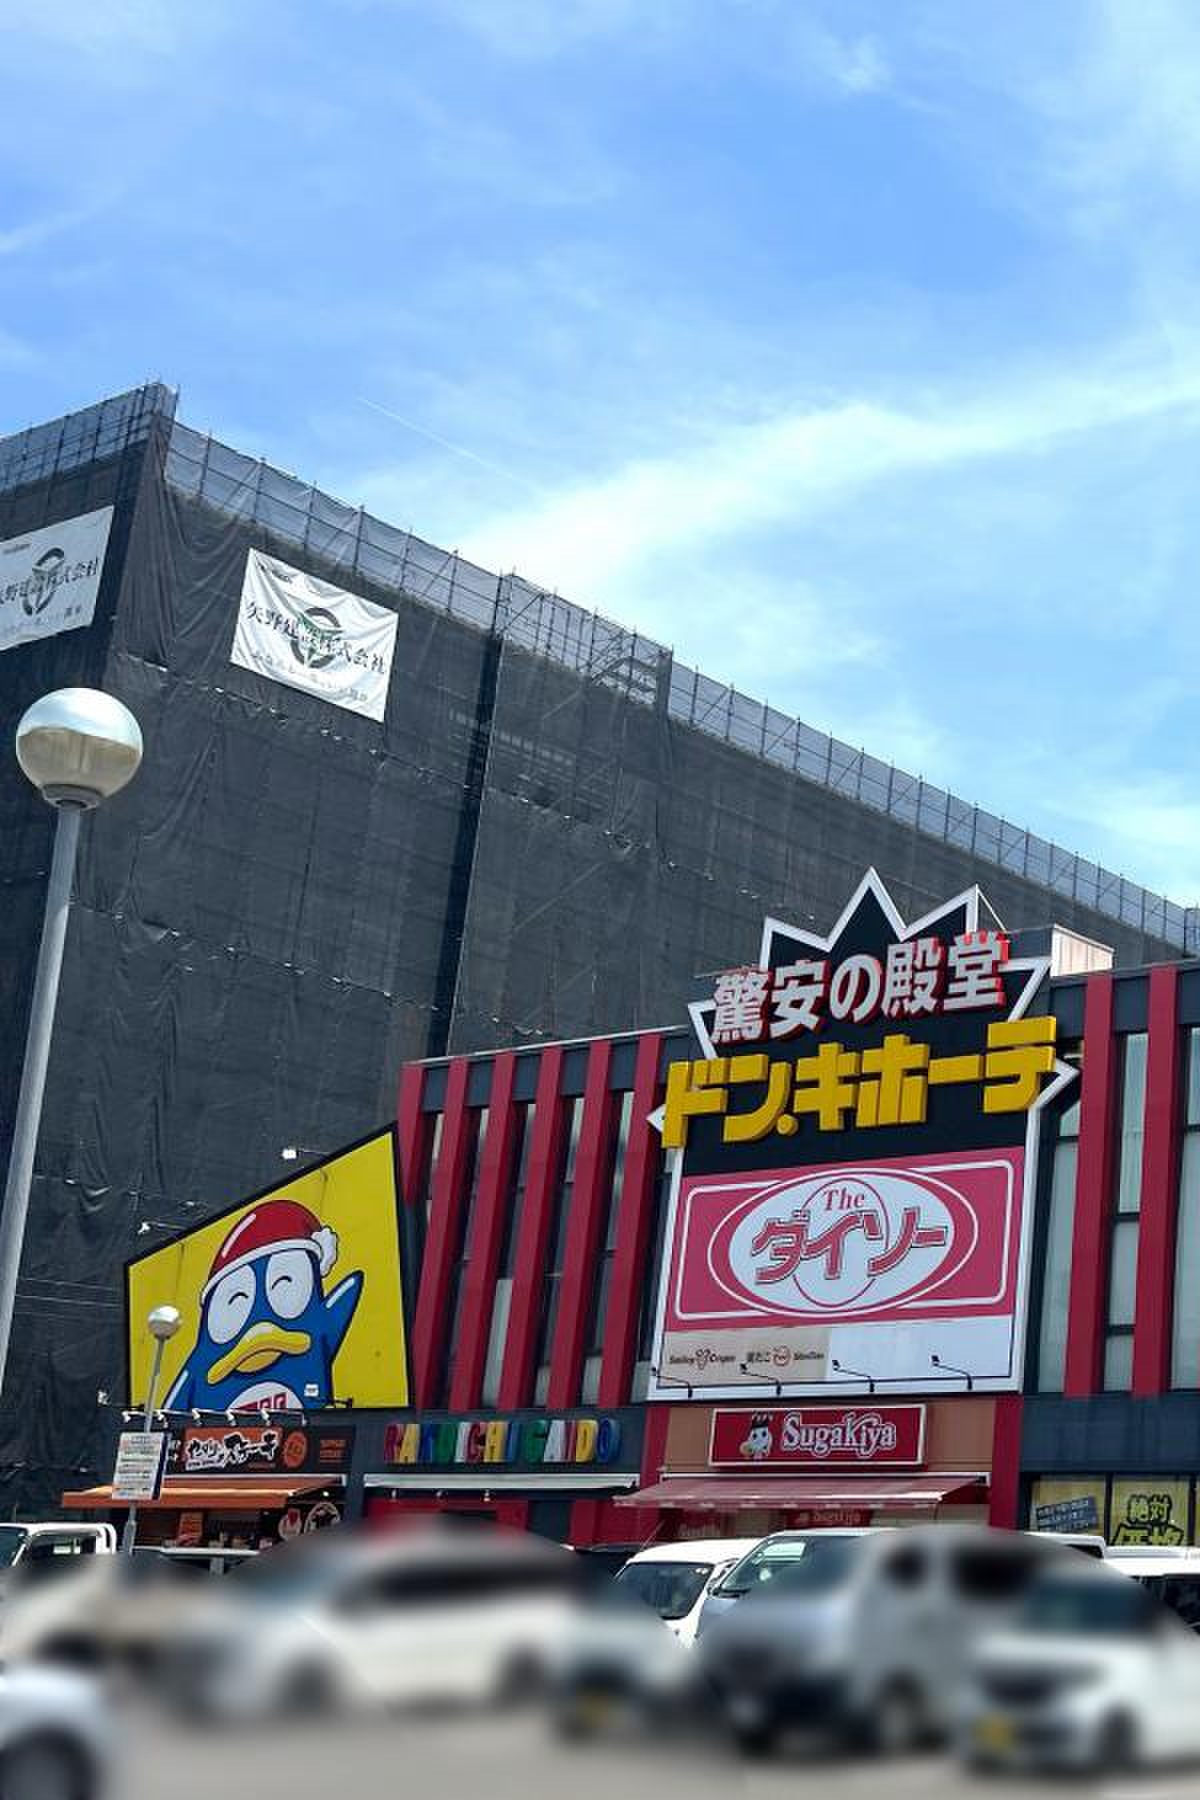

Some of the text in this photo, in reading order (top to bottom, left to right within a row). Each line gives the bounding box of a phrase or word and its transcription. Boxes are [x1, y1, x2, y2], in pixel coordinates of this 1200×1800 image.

[710, 929, 1012, 1044] 驚安の殿堂
[823, 1187, 866, 1213] The
[751, 1207, 947, 1286] ダイソー
